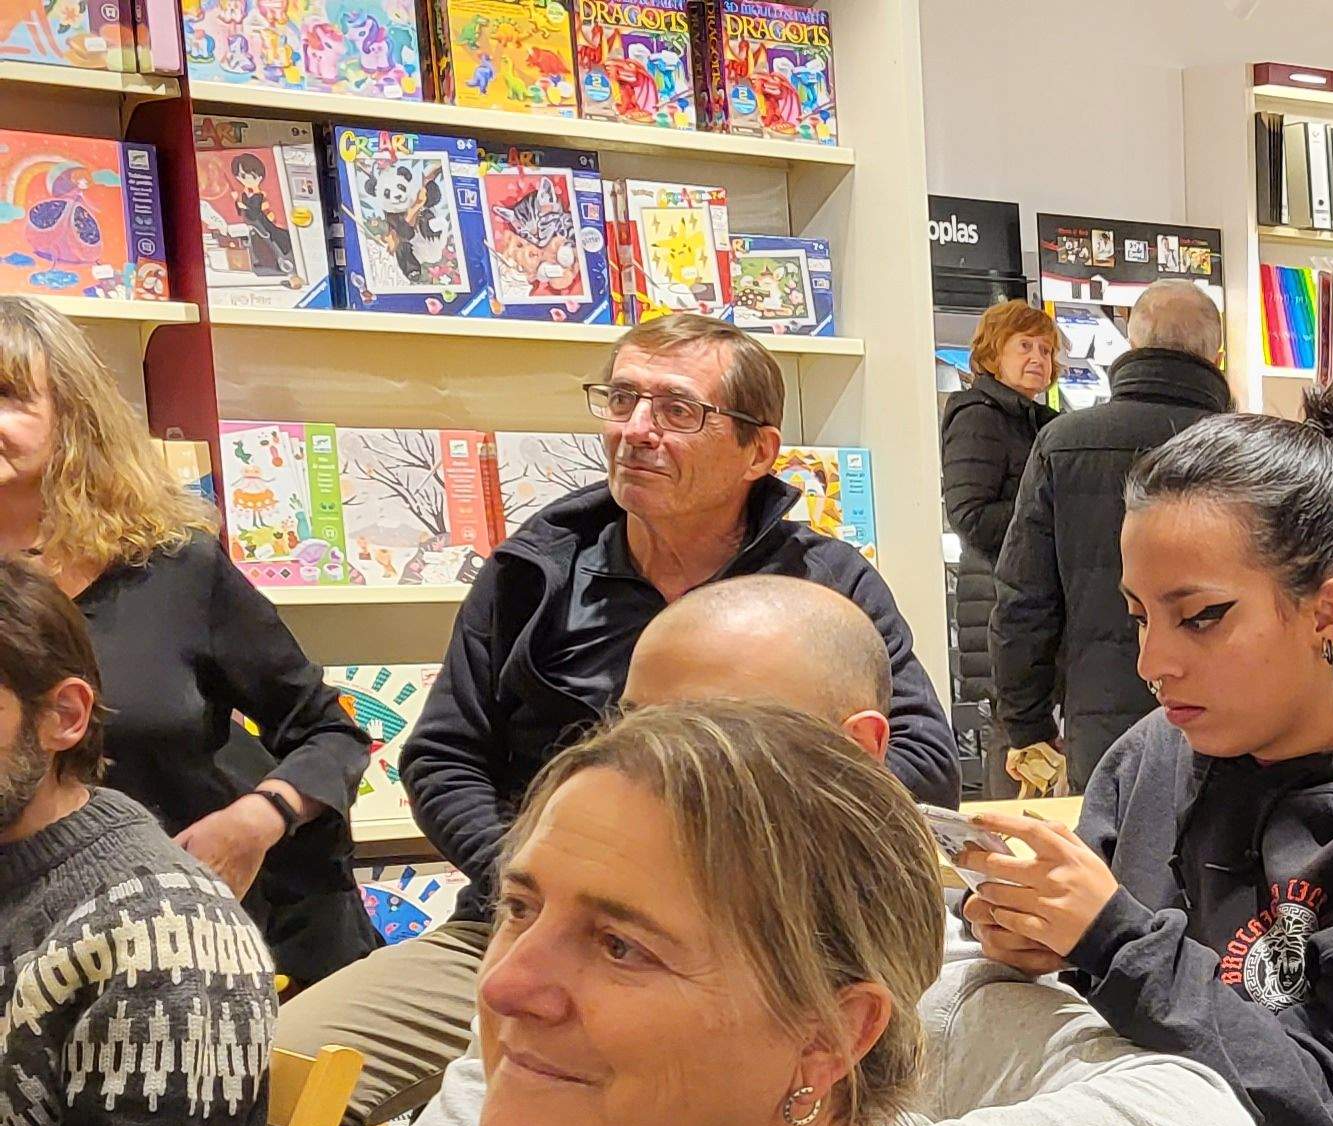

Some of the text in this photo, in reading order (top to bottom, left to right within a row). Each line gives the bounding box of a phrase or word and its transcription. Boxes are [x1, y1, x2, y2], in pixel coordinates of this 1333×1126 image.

[723, 13, 830, 46] DRAGONS
[339, 130, 419, 161] CREART
[457, 138, 474, 150] 9+
[928, 214, 979, 245] oplas
